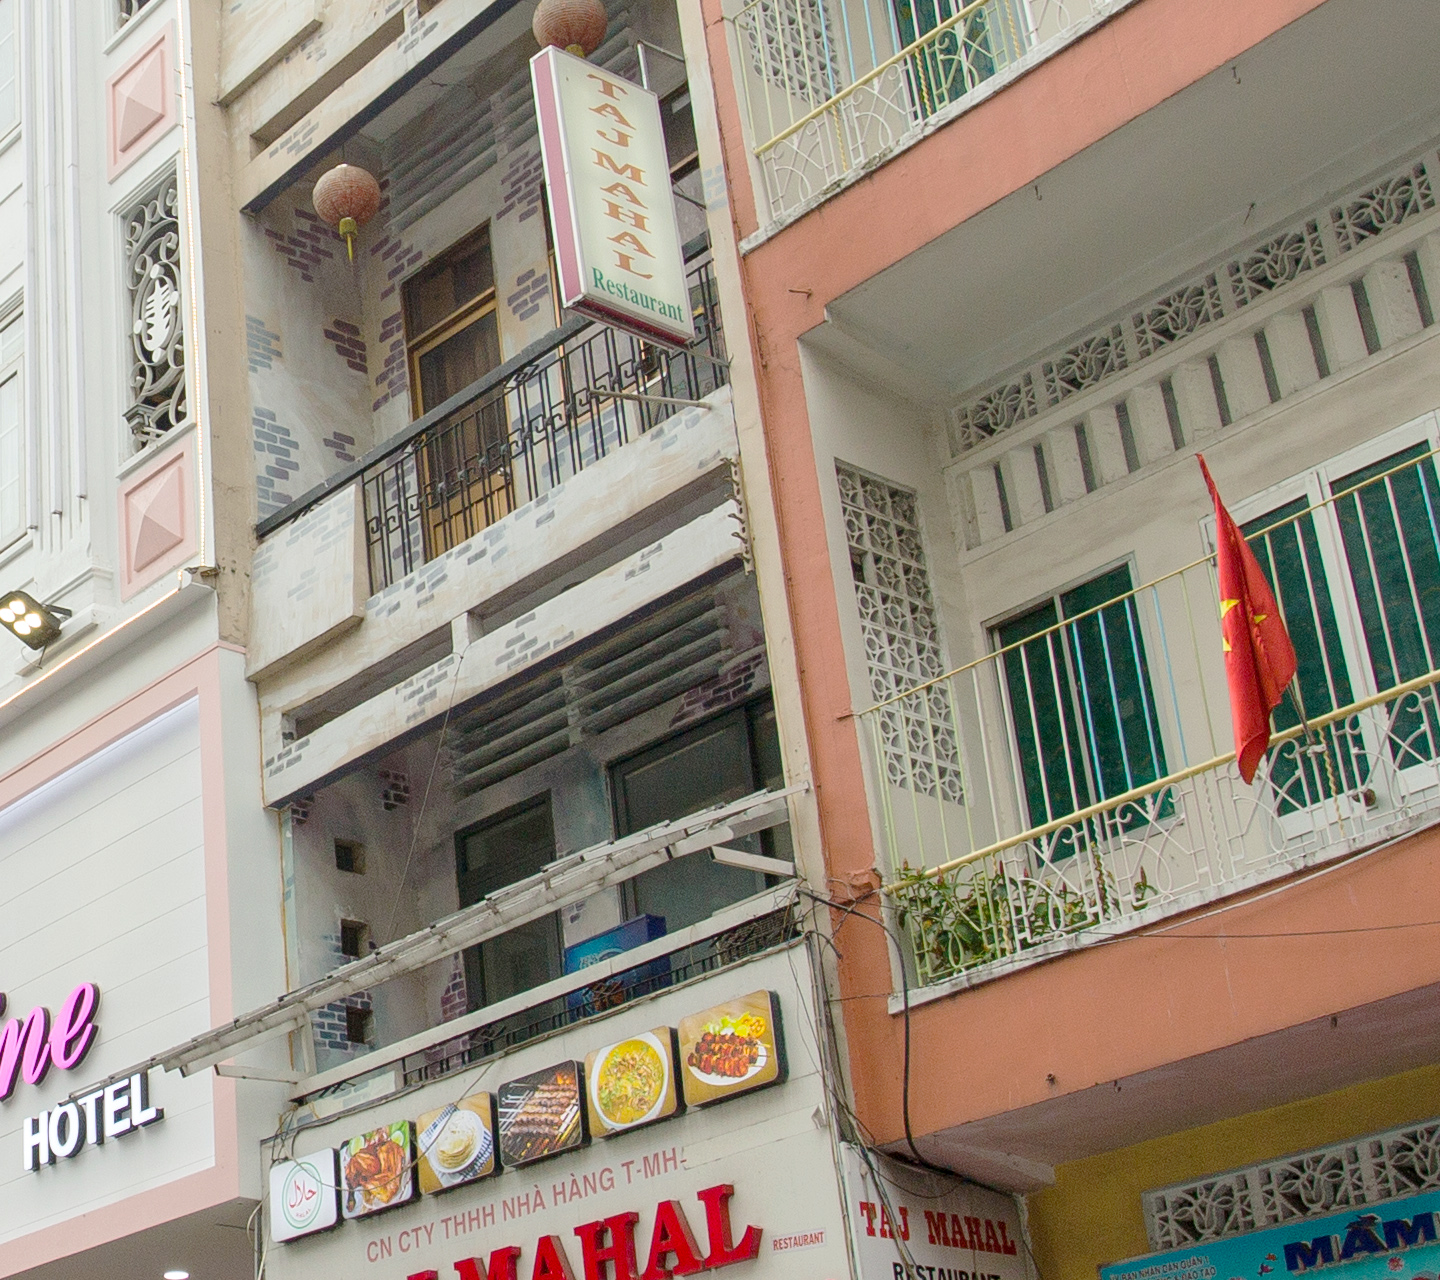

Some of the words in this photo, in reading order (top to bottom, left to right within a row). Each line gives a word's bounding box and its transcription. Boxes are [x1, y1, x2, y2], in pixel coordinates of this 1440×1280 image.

[592, 266, 685, 324] Restaurant
[22, 1067, 166, 1173] HOTEL
[366, 1238, 393, 1264] CN
[398, 1224, 436, 1257] CTY
[502, 1183, 549, 1223] NHÀ
[553, 1166, 617, 1208] HÀNG
[772, 1230, 826, 1253] RESTAURANT
[859, 1201, 910, 1241] TAJ
[924, 1210, 1017, 1256] MAHAL
